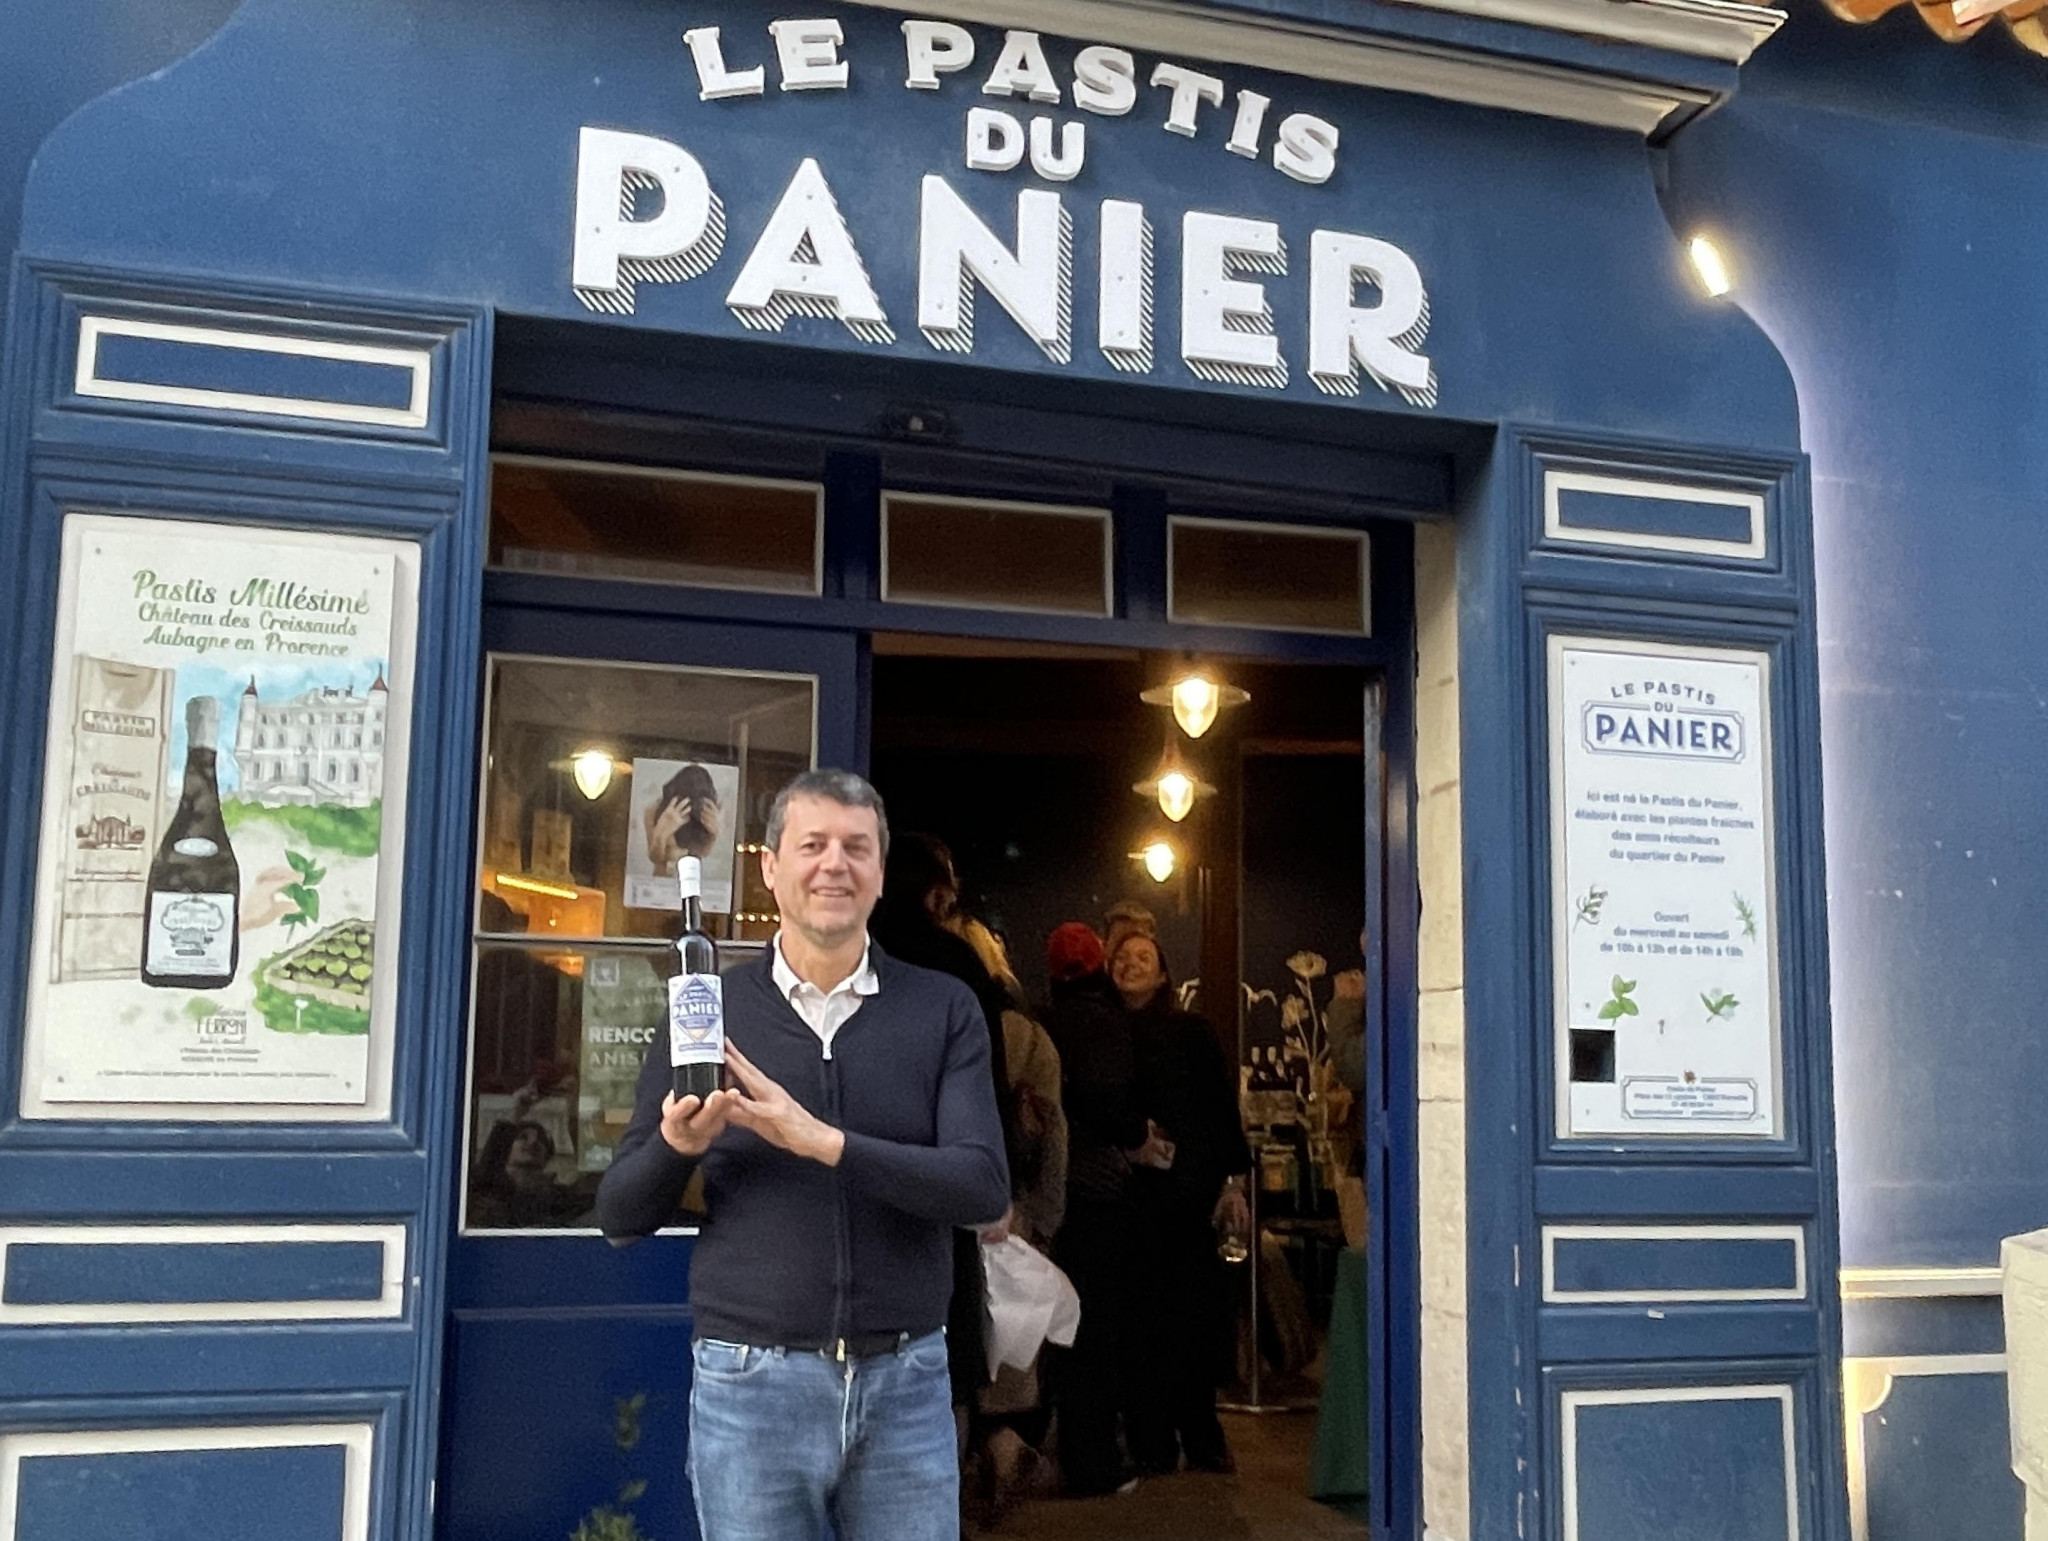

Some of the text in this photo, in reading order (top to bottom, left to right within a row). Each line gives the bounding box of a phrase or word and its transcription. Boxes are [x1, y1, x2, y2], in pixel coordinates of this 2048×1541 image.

[683, 19, 1339, 184] LE PASTIS
[967, 107, 1085, 182] DU
[573, 127, 1437, 403] PANIER
[133, 569, 216, 603] Pastis
[138, 602, 213, 626] Château
[219, 609, 249, 628] des
[143, 625, 348, 656] Aubagne en Provence
[1611, 681, 1715, 705] LE PASTIS
[1654, 702, 1674, 713] DU
[1595, 713, 1733, 750] PANIER
[1652, 794, 1685, 807] Pastis
